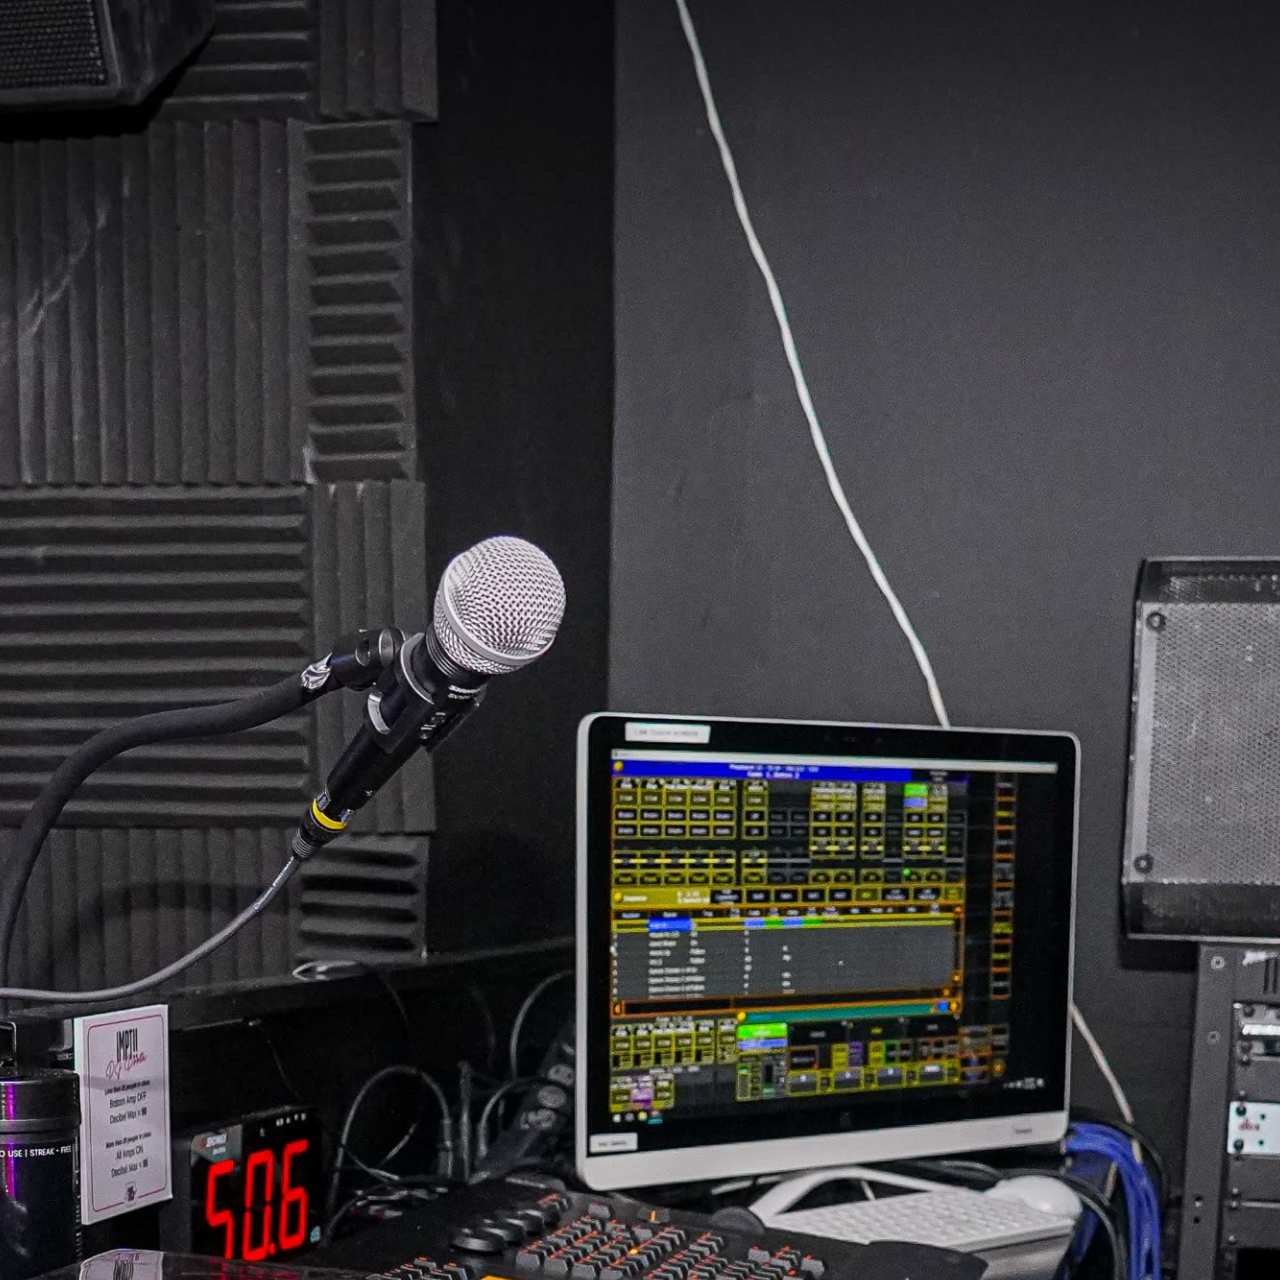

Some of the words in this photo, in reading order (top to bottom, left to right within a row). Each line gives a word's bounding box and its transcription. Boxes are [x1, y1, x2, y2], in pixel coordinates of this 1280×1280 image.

[7, 1150, 23, 1158] USE
[29, 1148, 55, 1157] STREAK
[205, 1138, 309, 1261] 50.6
